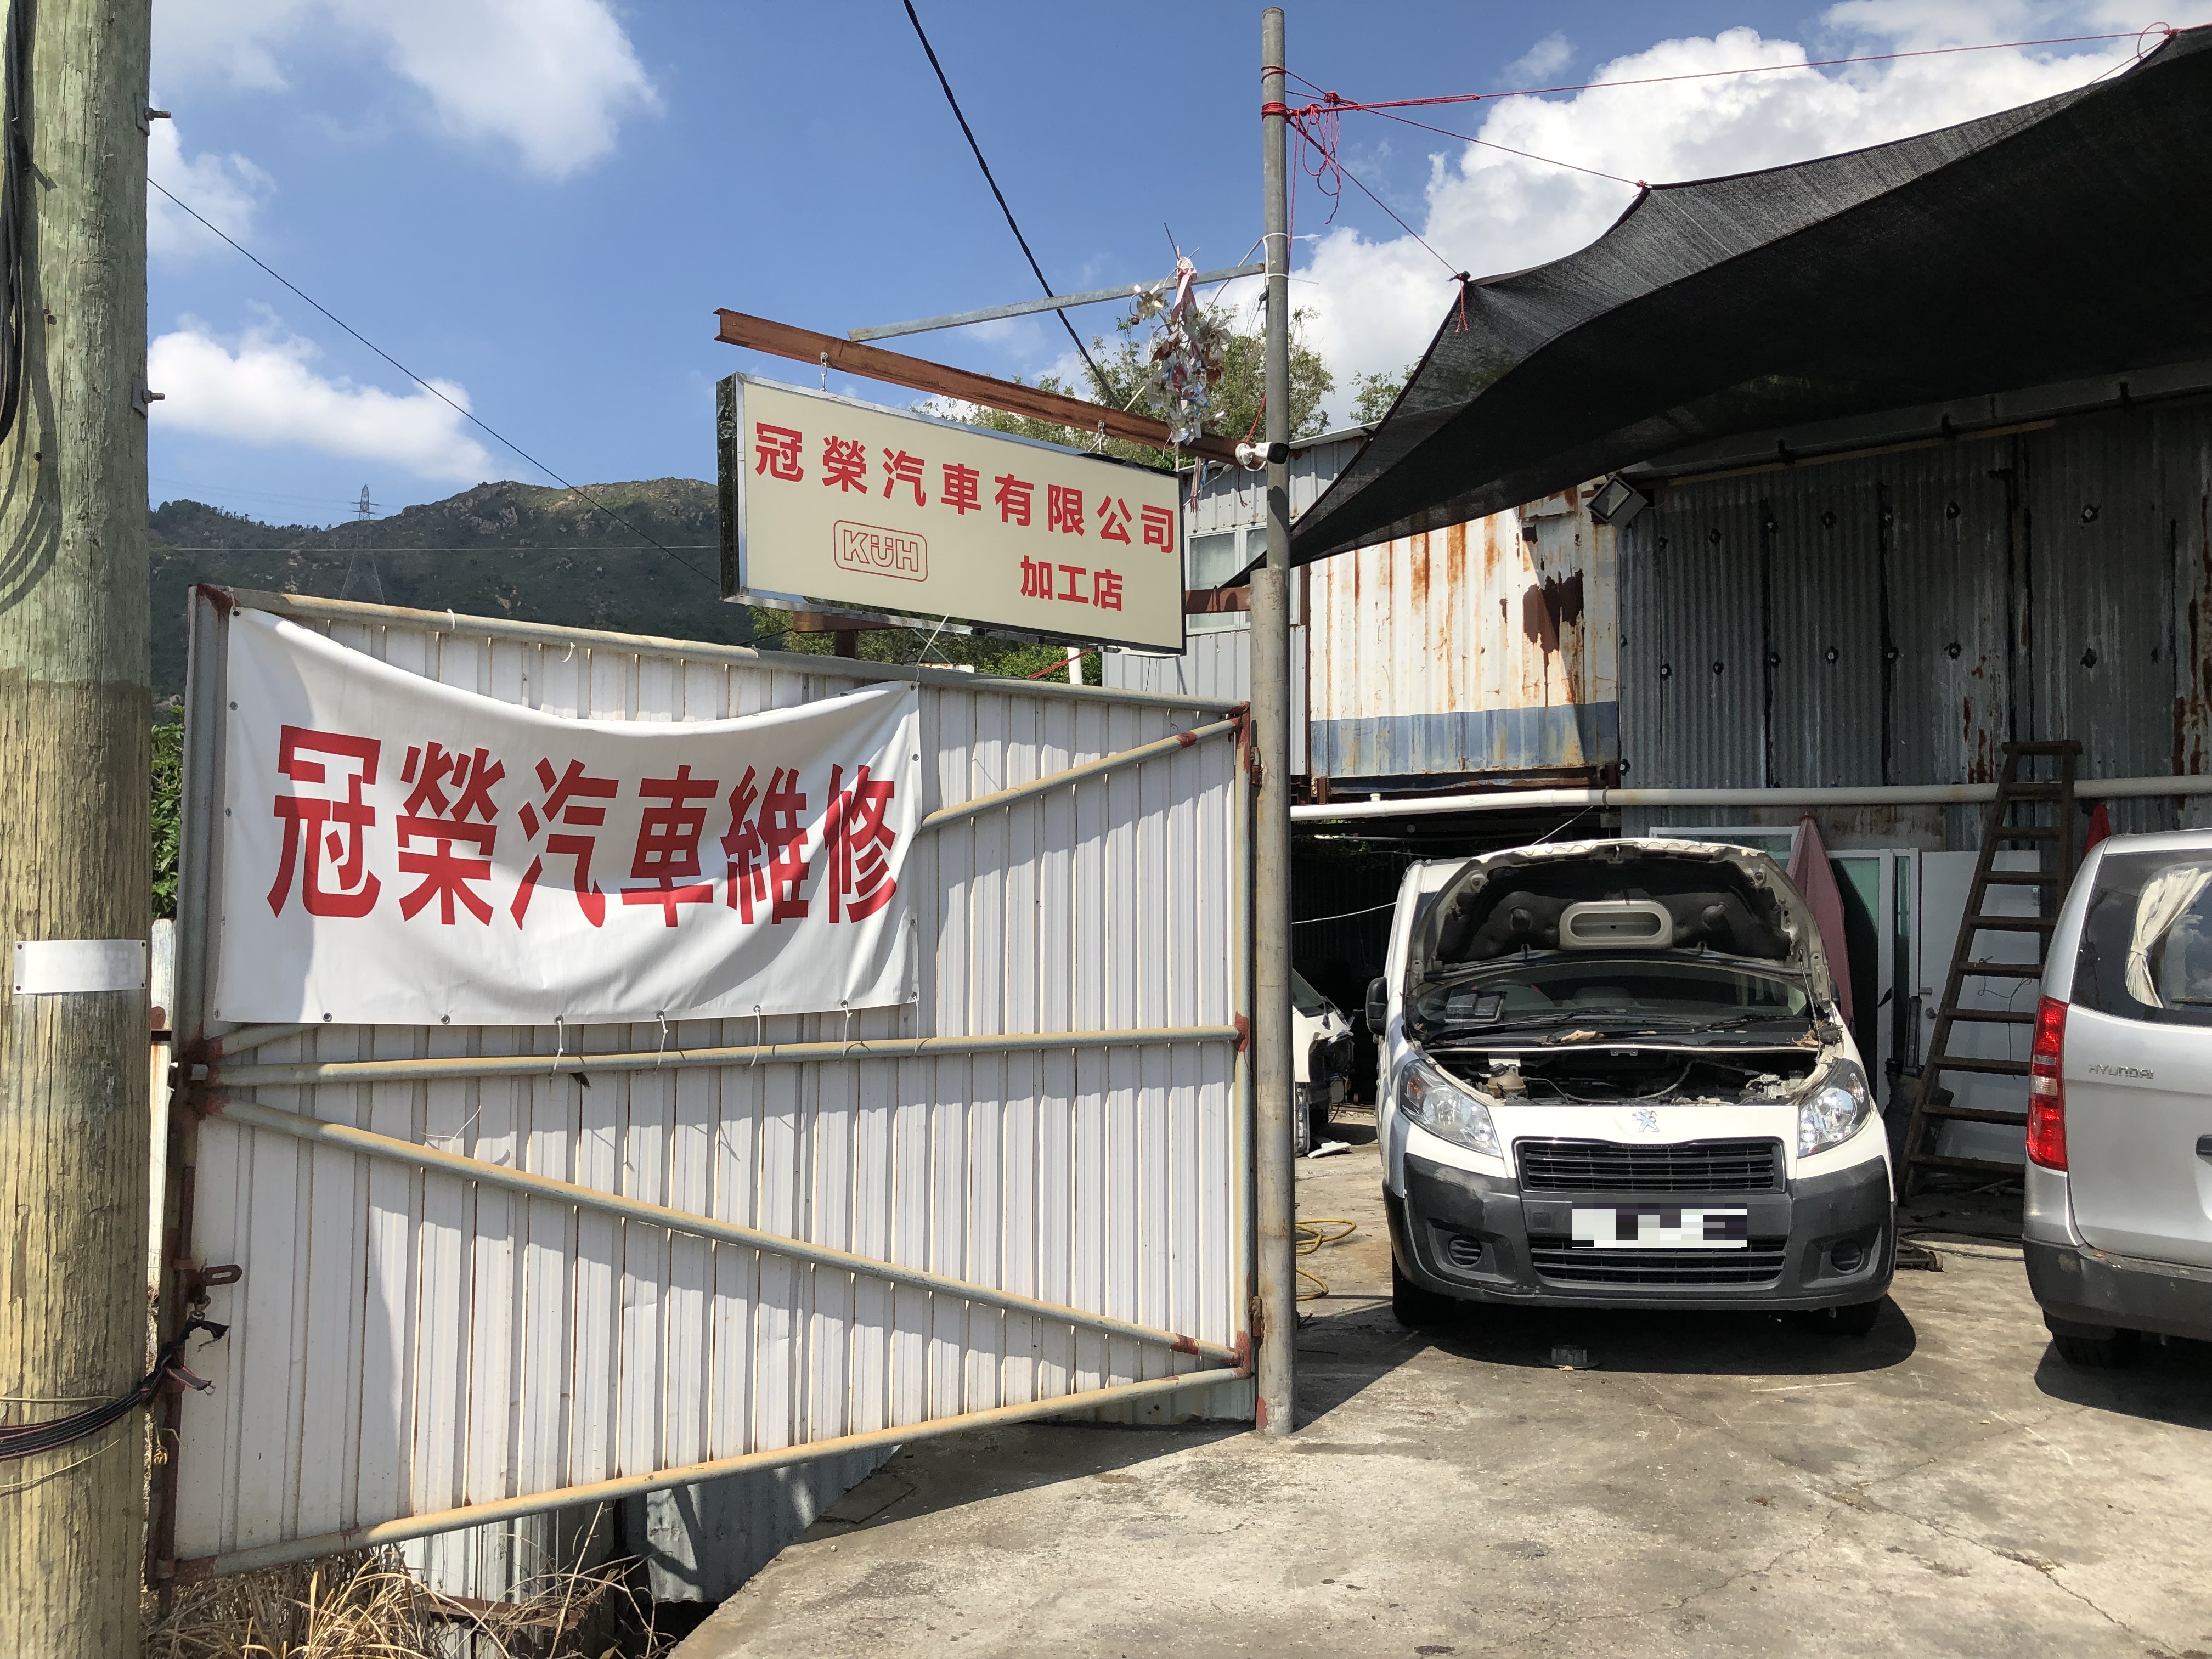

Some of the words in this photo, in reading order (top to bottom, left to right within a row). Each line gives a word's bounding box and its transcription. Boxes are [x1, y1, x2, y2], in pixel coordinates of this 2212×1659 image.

[755, 421, 1175, 554] 冠榮汽車有限公司
[1020, 555, 1124, 612] 加工店
[266, 725, 898, 930] 冠榮汽車維修
[2088, 1064, 2154, 1080] HYUNDAI
